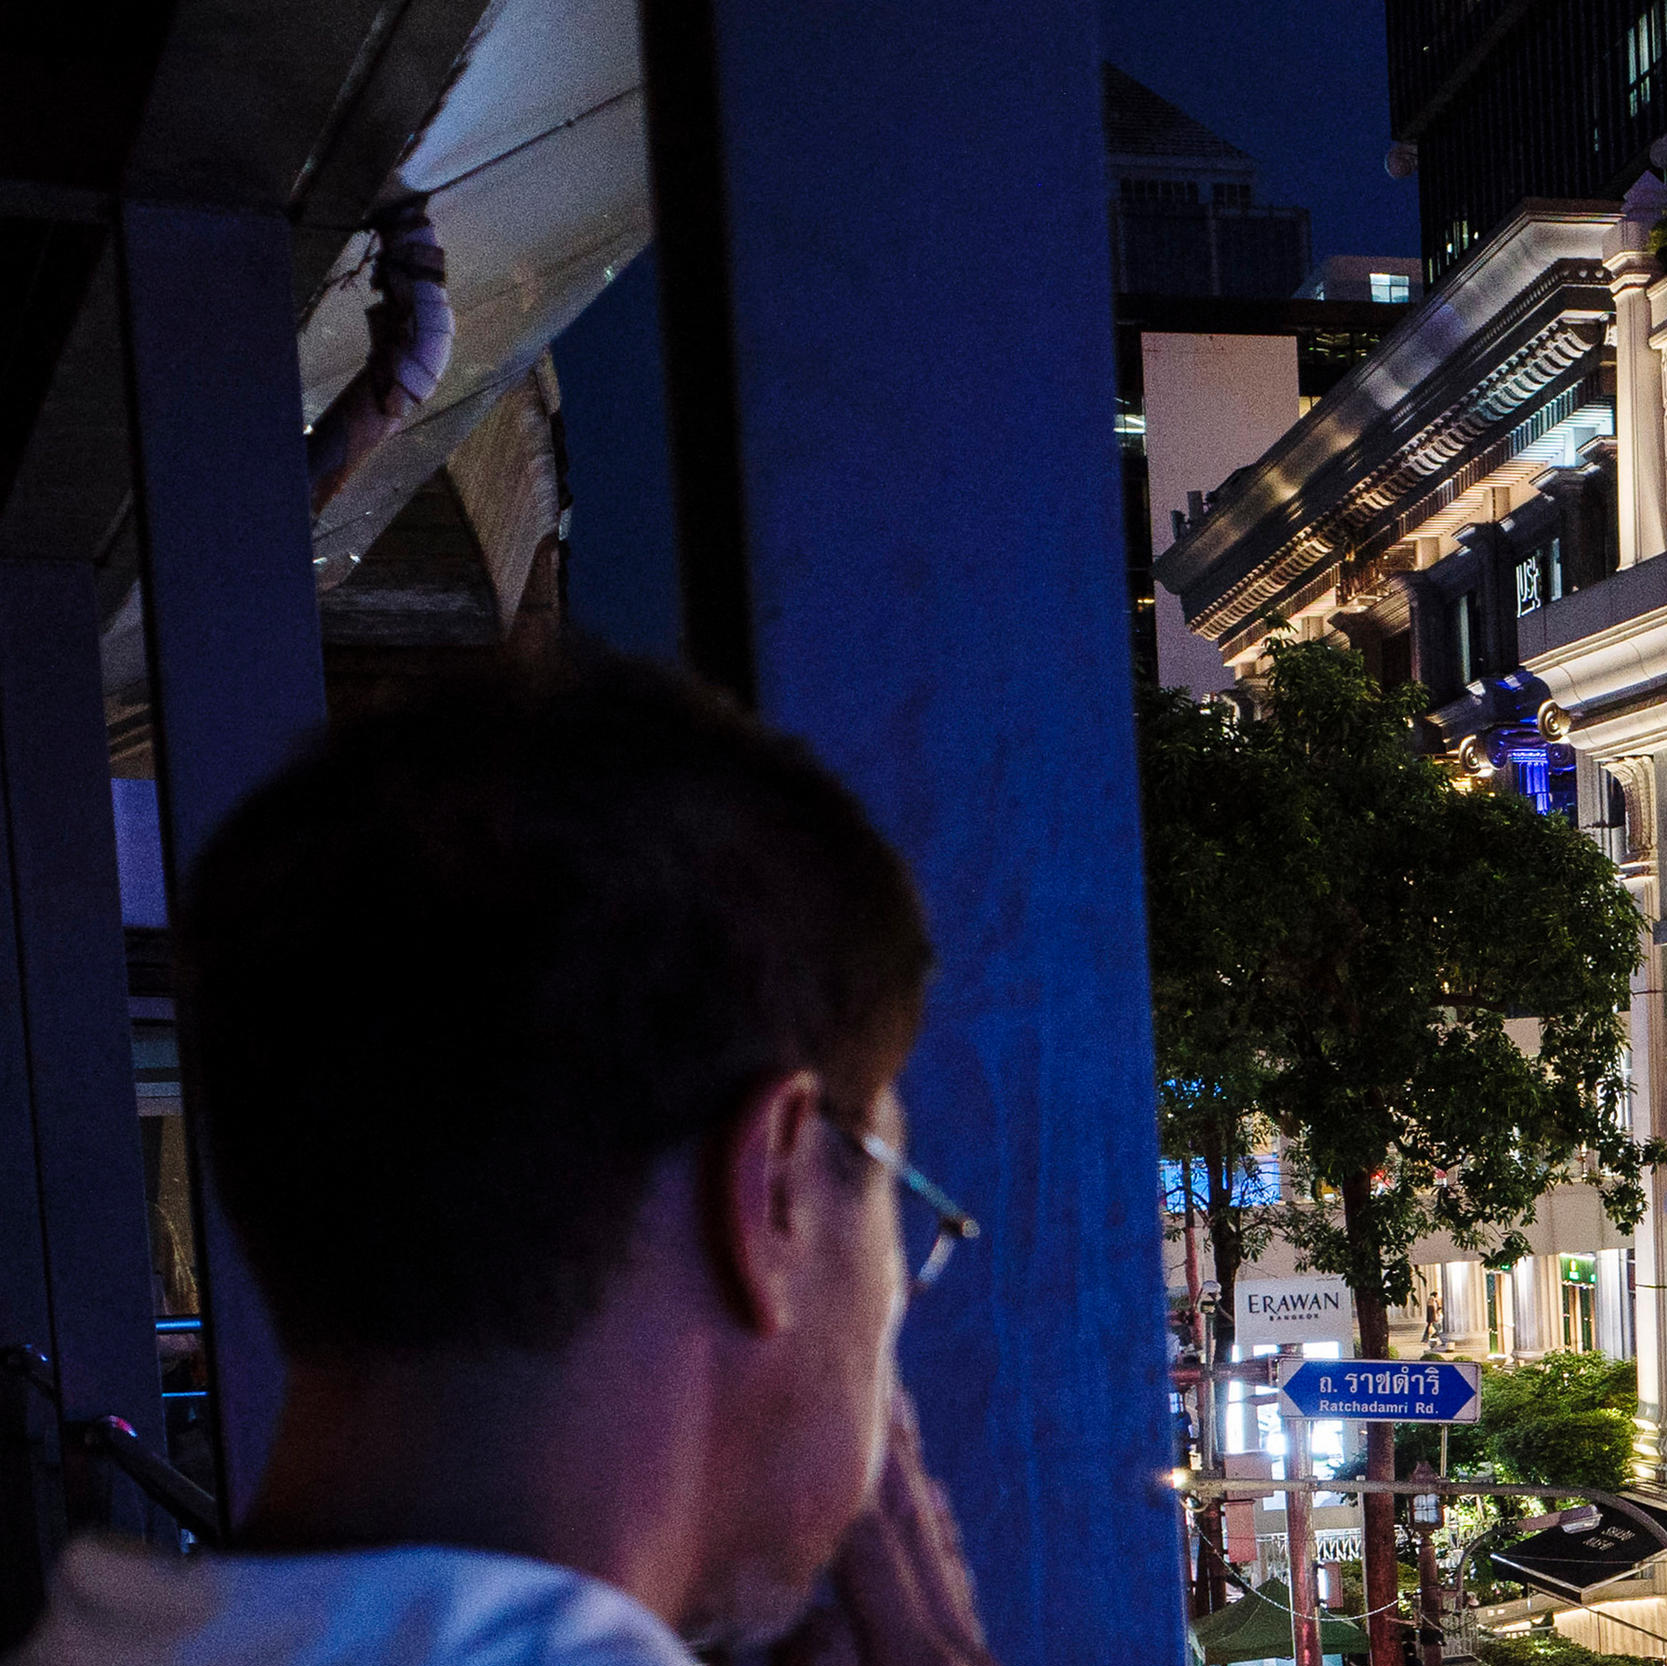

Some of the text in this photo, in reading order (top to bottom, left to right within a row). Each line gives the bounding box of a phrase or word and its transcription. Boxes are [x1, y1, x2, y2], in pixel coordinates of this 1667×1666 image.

[1249, 1292, 1340, 1315] ERAWAN
[1345, 1366, 1440, 1396] ราชดำริ
[1319, 1400, 1439, 1414] Ratchadamri Rd.
